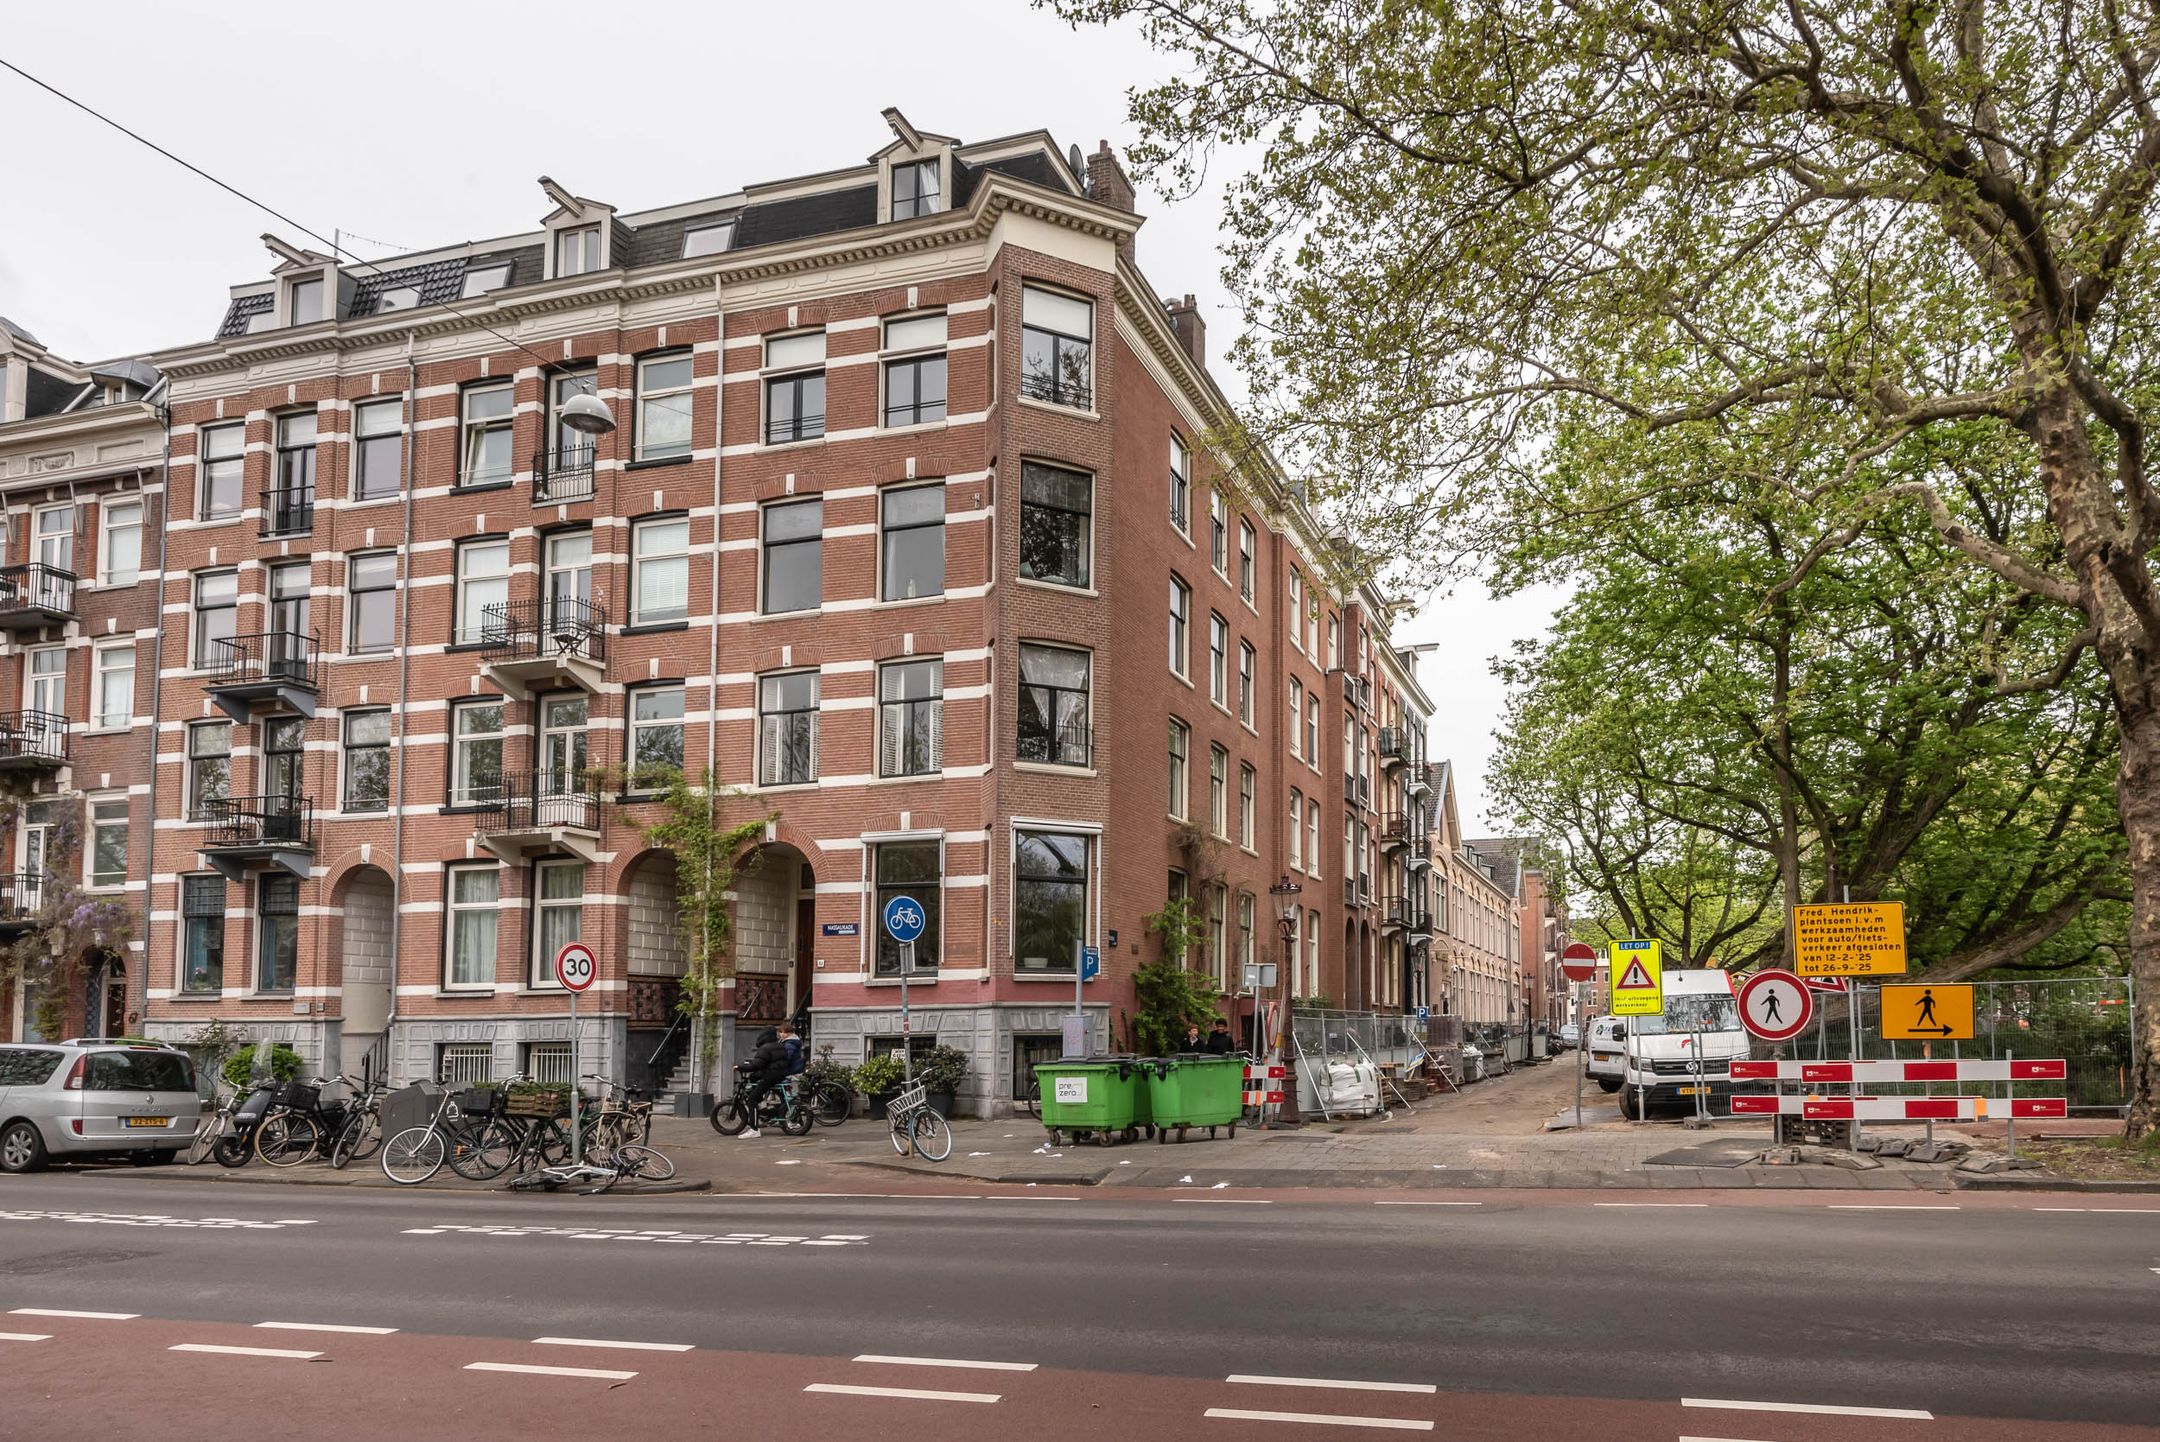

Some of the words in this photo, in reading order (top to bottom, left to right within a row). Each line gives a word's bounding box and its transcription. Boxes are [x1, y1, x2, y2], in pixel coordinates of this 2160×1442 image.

[1799, 909, 1826, 917] Fred.
[1831, 906, 1879, 915] Hendrik-
[1800, 917, 1851, 926] plantsoen
[1801, 925, 1886, 935] werkzaamheden
[1827, 933, 1888, 942] auto/fiets-
[1802, 944, 1842, 952] verkeer
[1846, 943, 1901, 952] afgesloten
[1825, 953, 1872, 961] 12-2-'25
[565, 958, 590, 976] 30
[1086, 956, 1093, 970] P
[1804, 964, 1819, 972] tot
[1823, 963, 1872, 972] 26-9-'25
[1418, 1008, 1426, 1018] P
